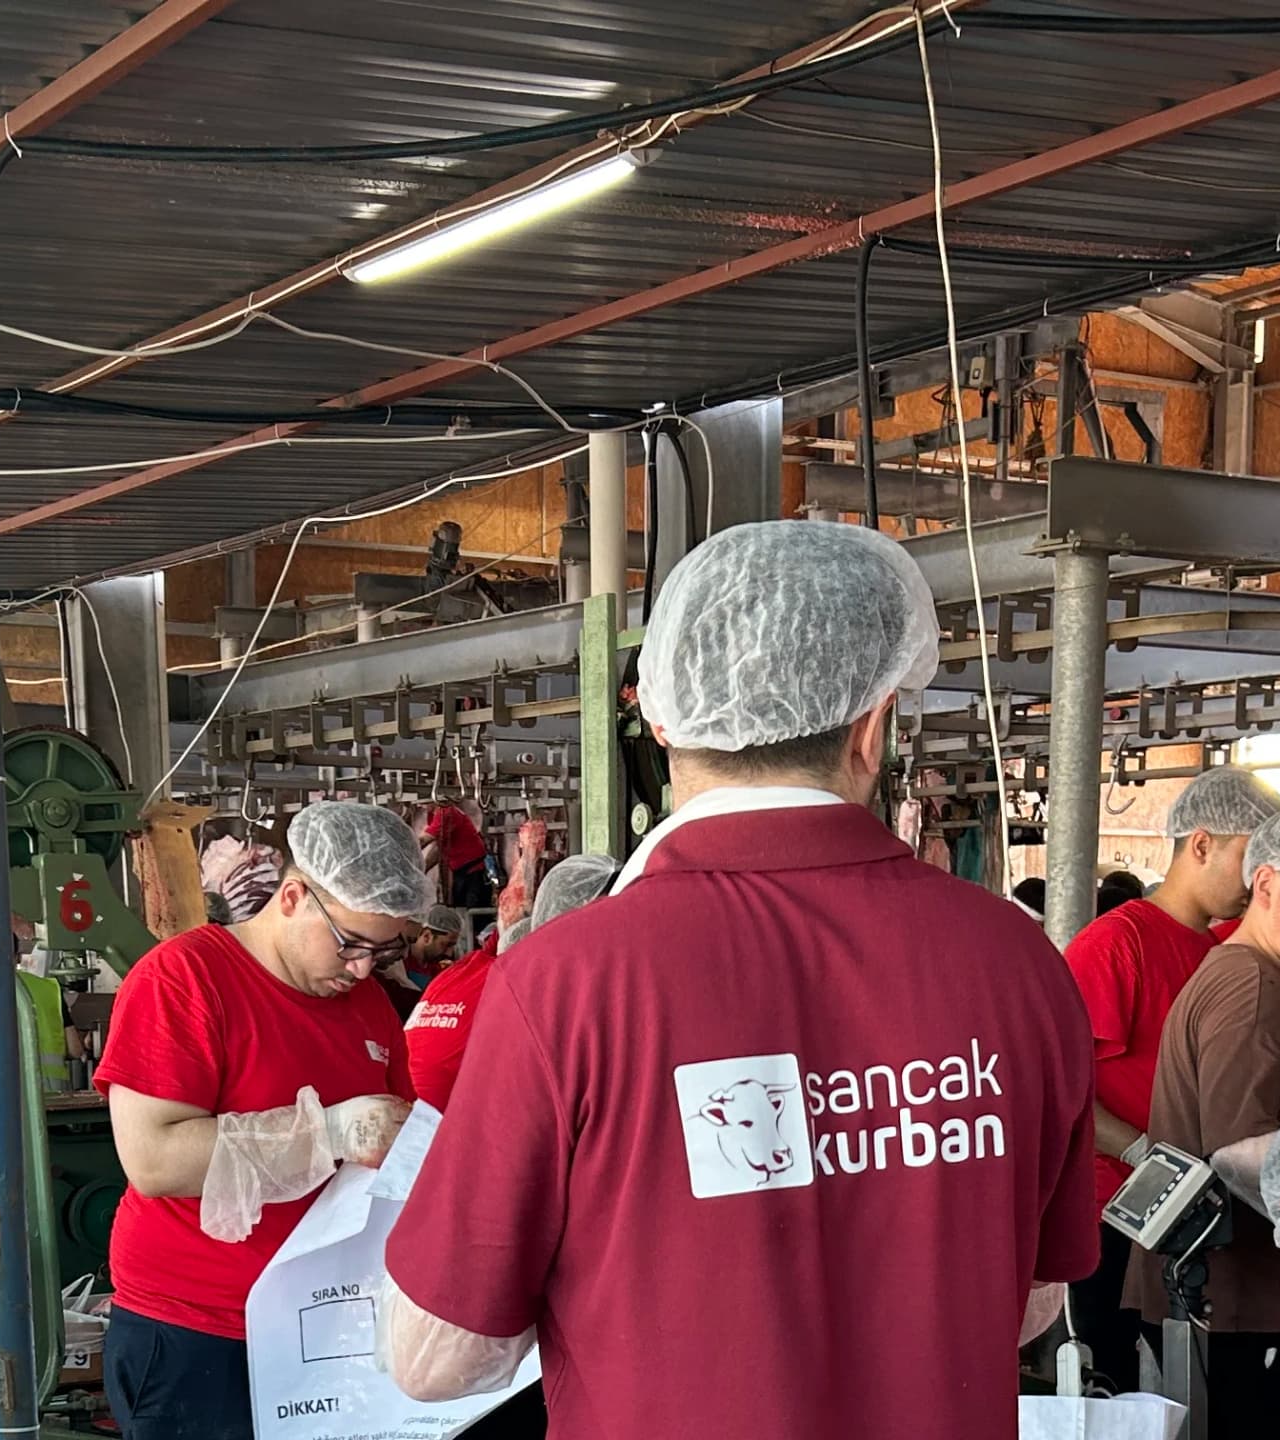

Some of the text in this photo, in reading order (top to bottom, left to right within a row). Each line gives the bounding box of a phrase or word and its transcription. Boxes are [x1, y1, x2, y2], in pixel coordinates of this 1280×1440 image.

[60, 880, 94, 932] 6
[805, 1037, 1003, 1117] sancak
[811, 1107, 1006, 1177] kurban
[311, 1283, 360, 1302] SIRA NO
[277, 1397, 340, 1419] DİKKAT!
